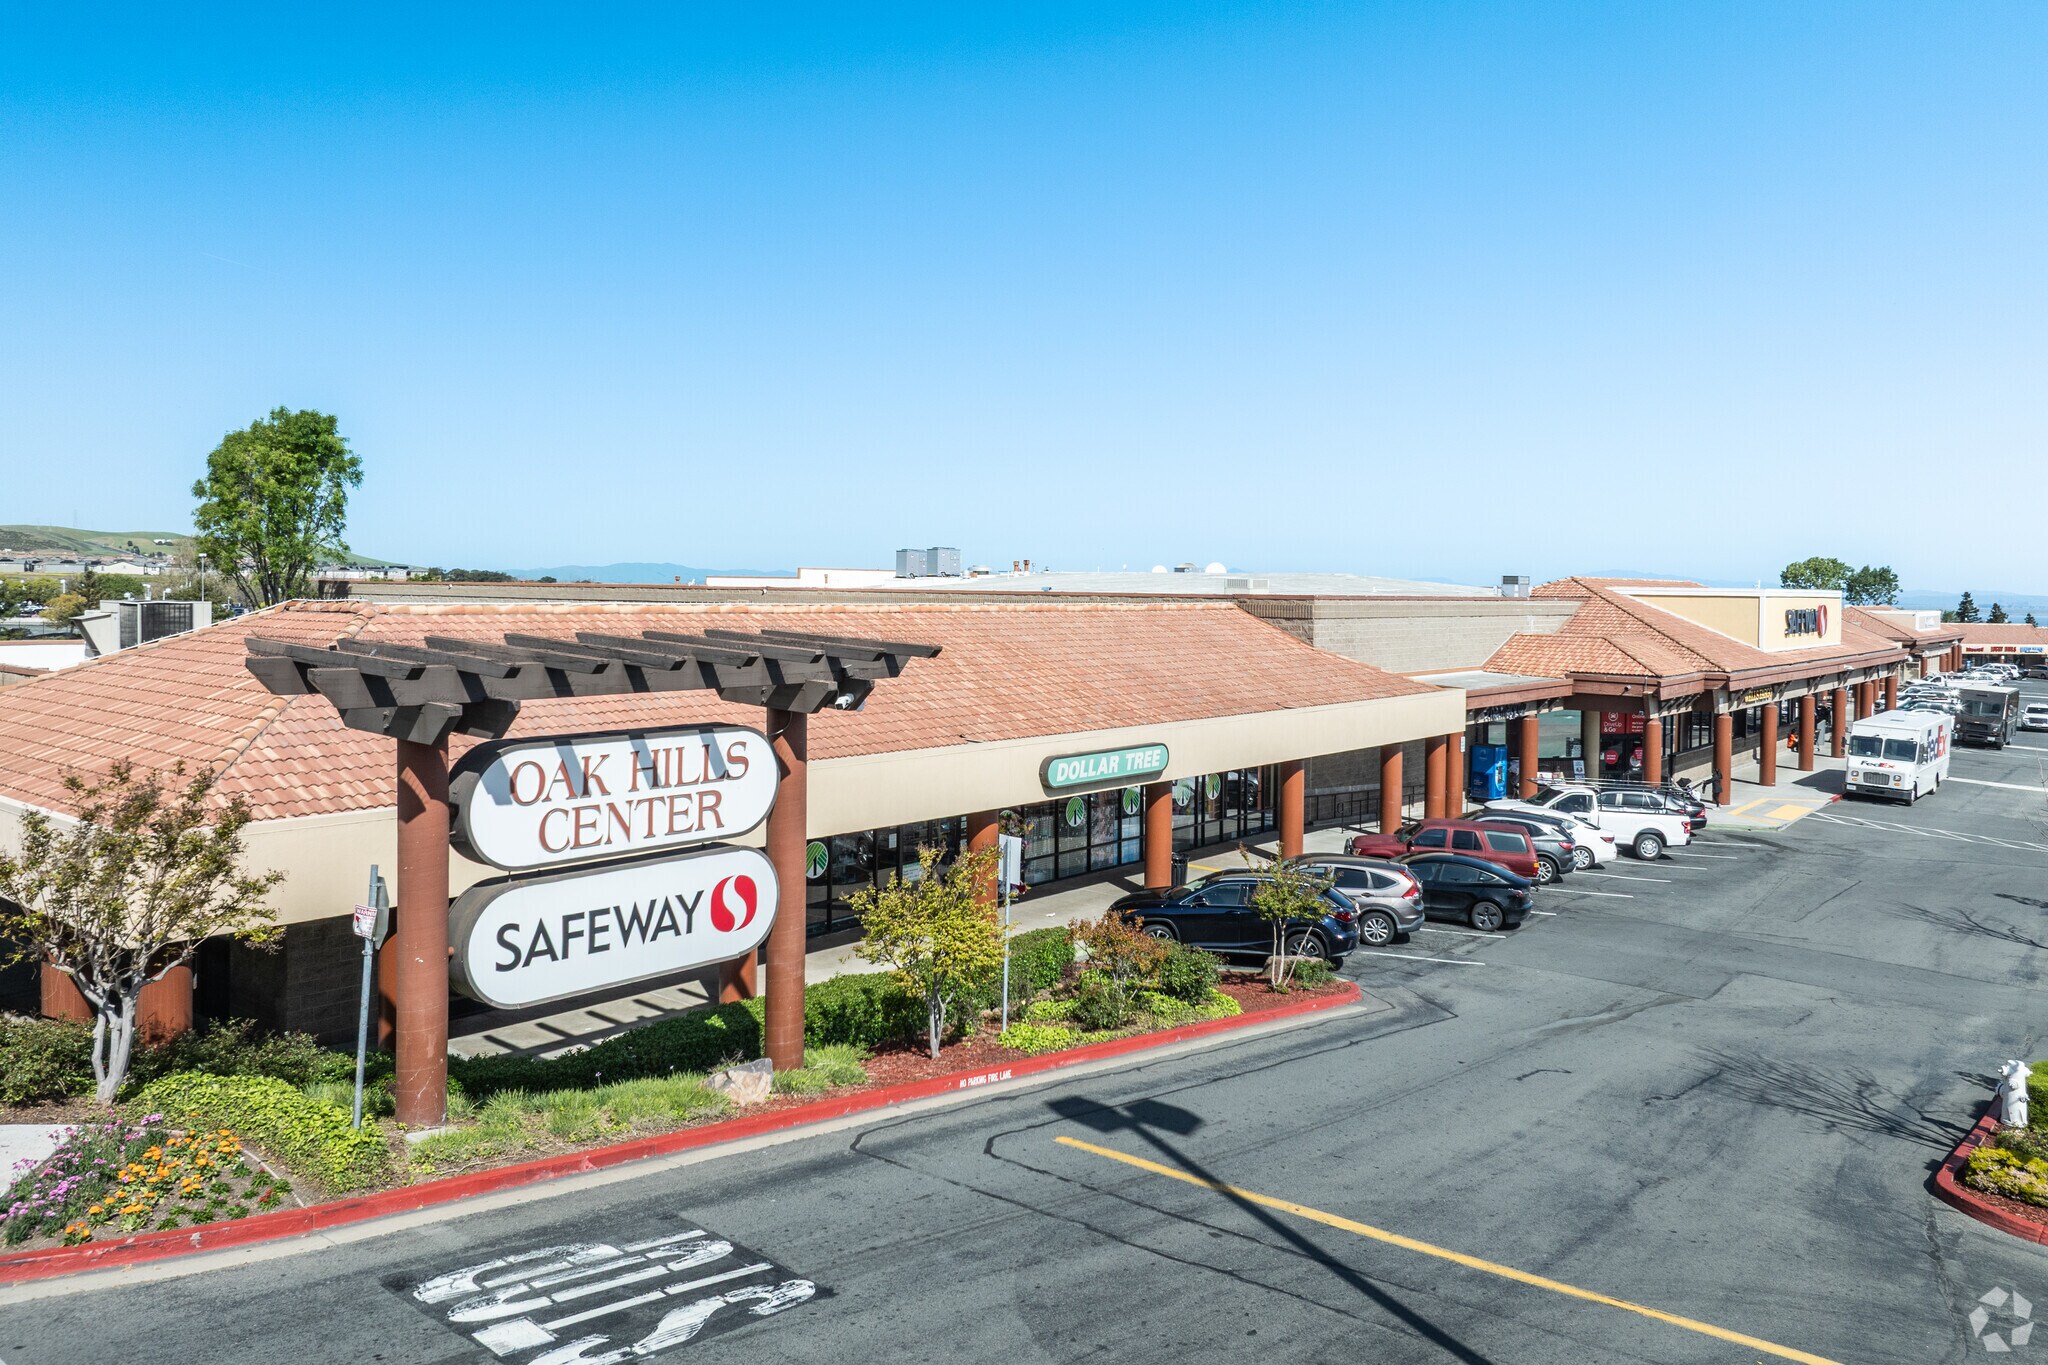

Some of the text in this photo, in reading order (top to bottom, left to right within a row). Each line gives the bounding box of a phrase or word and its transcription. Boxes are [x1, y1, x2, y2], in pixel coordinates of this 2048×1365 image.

[510, 741, 749, 806] OAK HILLS
[1056, 749, 1161, 782] DOLLAR TREE
[1860, 760, 1895, 769] FedEx
[538, 790, 725, 853] CENTER
[495, 890, 705, 972] SAFEWAY
[960, 1069, 1012, 1088] NO PARKING FIRE LANE
